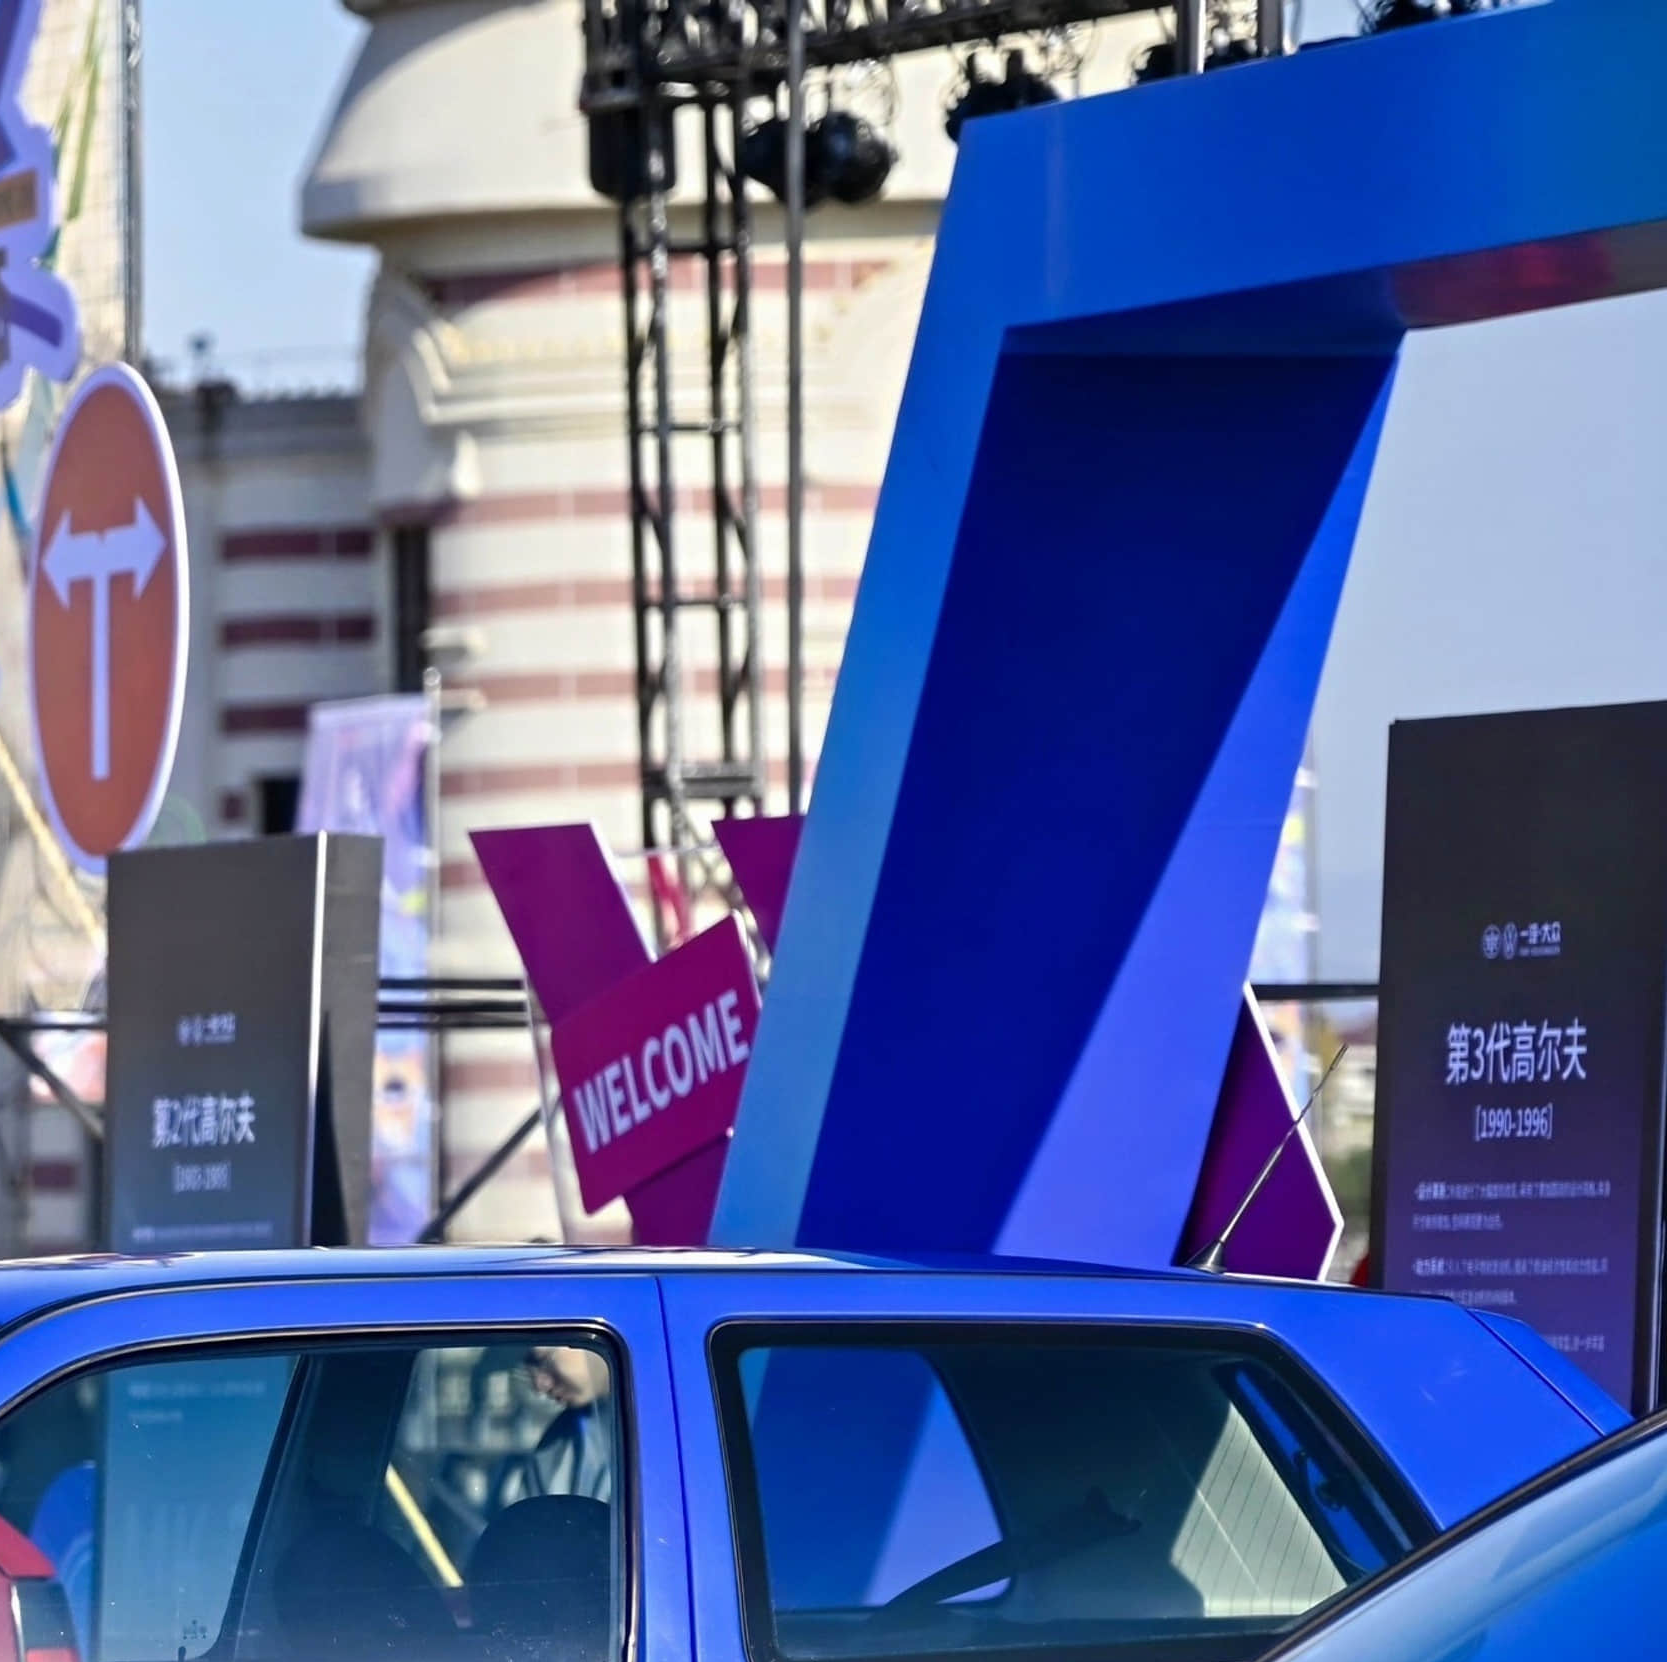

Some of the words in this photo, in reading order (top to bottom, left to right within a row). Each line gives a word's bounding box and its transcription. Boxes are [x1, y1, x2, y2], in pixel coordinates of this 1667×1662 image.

[573, 988, 750, 1155] WELCOME
[1445, 1017, 1588, 1085] 第3代高尔夫
[1474, 1103, 1554, 1142] [1990-1996]
